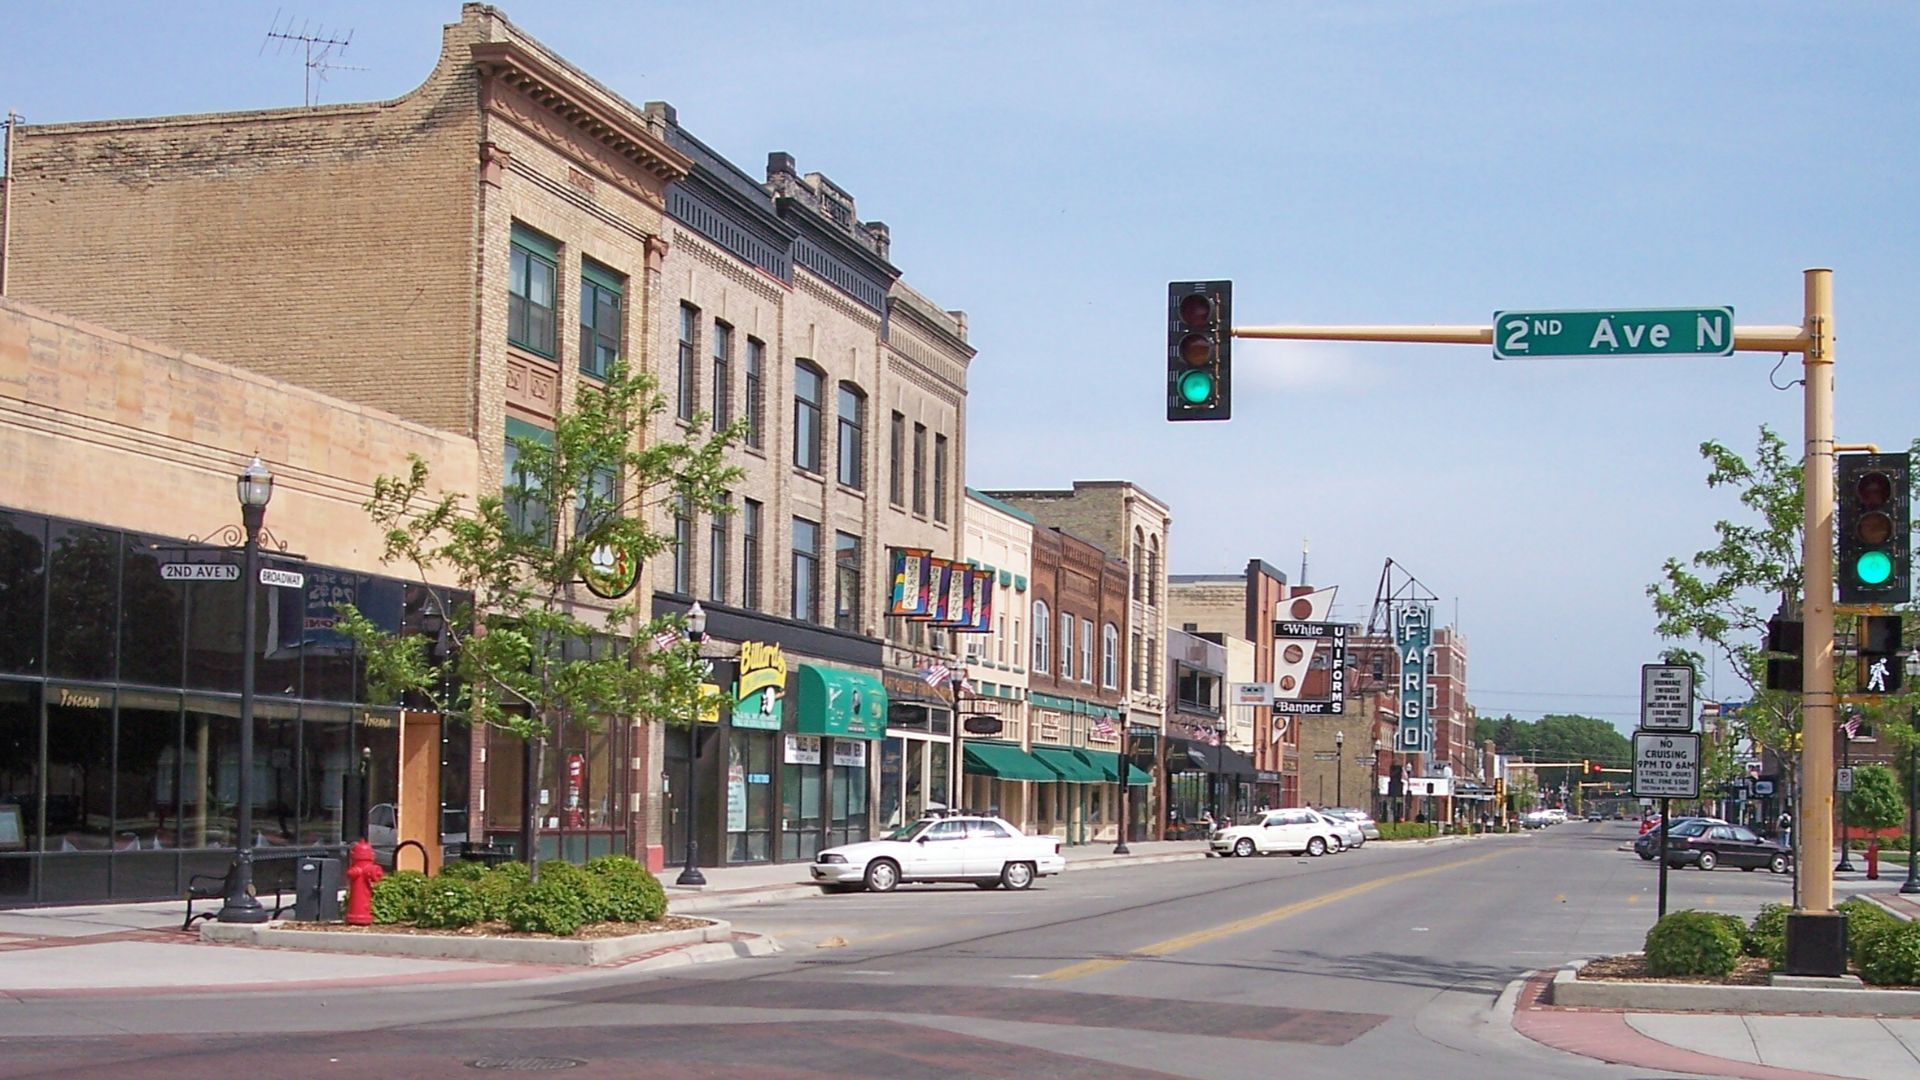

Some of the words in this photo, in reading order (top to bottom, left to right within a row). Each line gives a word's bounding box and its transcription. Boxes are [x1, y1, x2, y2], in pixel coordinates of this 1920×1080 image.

[1504, 320, 1562, 350] 2ND
[1589, 318, 1670, 348] Ave
[1697, 316, 1722, 347] N
[167, 566, 192, 577] 2ND
[196, 566, 221, 577] AVE
[226, 567, 236, 577] N
[262, 570, 301, 585] BROADWAY
[1282, 623, 1324, 637] White
[1331, 626, 1345, 714] UNIFORMS
[1404, 624, 1421, 746] FARGO
[1276, 701, 1324, 714] Banner
[1660, 740, 1673, 748] NO
[1645, 750, 1687, 759] CRUISING
[1637, 760, 1657, 769] 9PM
[1660, 760, 1672, 769] TO
[1675, 761, 1696, 769] 6AM
